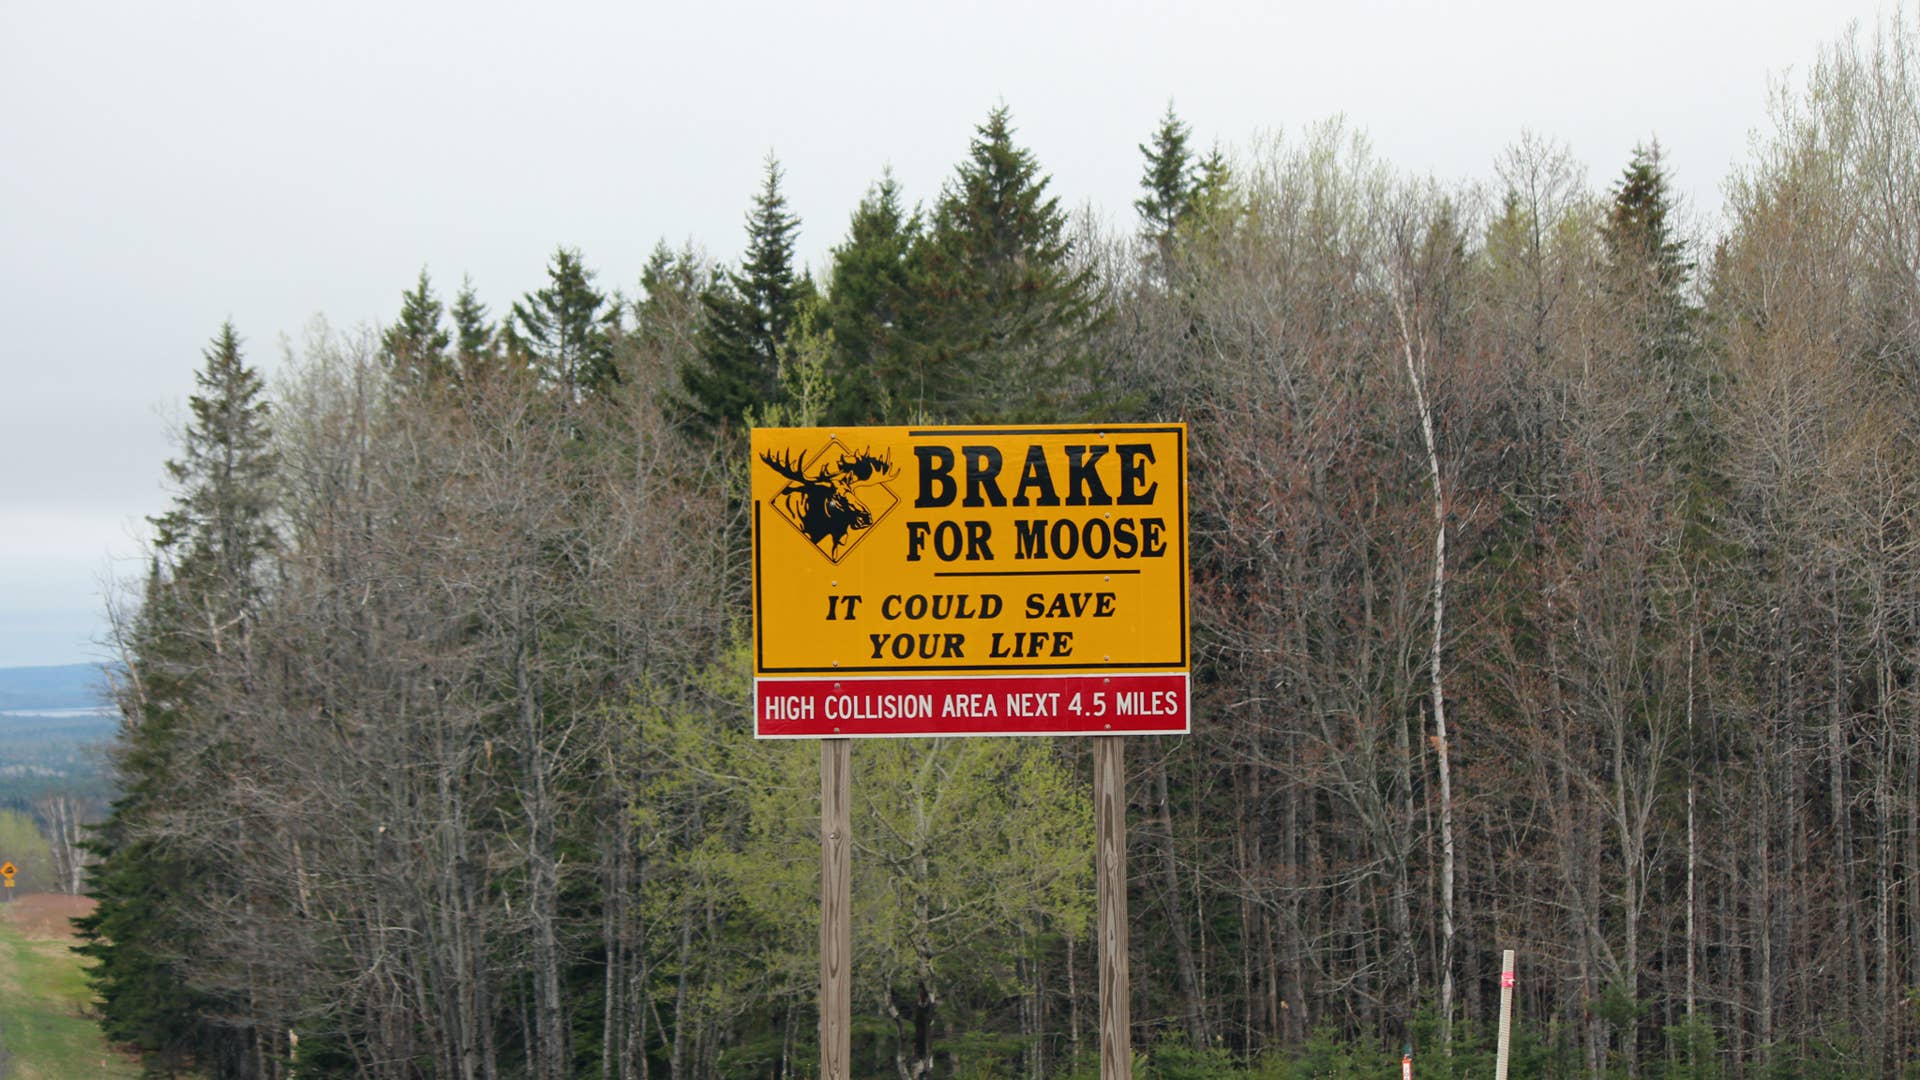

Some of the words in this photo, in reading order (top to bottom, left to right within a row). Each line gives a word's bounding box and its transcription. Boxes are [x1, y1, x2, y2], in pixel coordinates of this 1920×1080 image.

[914, 443, 1158, 508] BRAKE
[907, 520, 994, 562] FOR
[1015, 518, 1167, 559] MOOSE
[826, 595, 862, 620] IT
[881, 594, 1003, 620] COULD
[1026, 592, 1116, 618] SAVE
[870, 633, 965, 659] YOUR
[989, 632, 1073, 657] LIFE
[765, 696, 814, 720] HIGH
[825, 694, 933, 719] COLLISION
[942, 694, 997, 717] AREA
[1007, 692, 1059, 717] NEXT
[1068, 693, 1106, 716] 4.5
[1116, 691, 1178, 715] MILES
